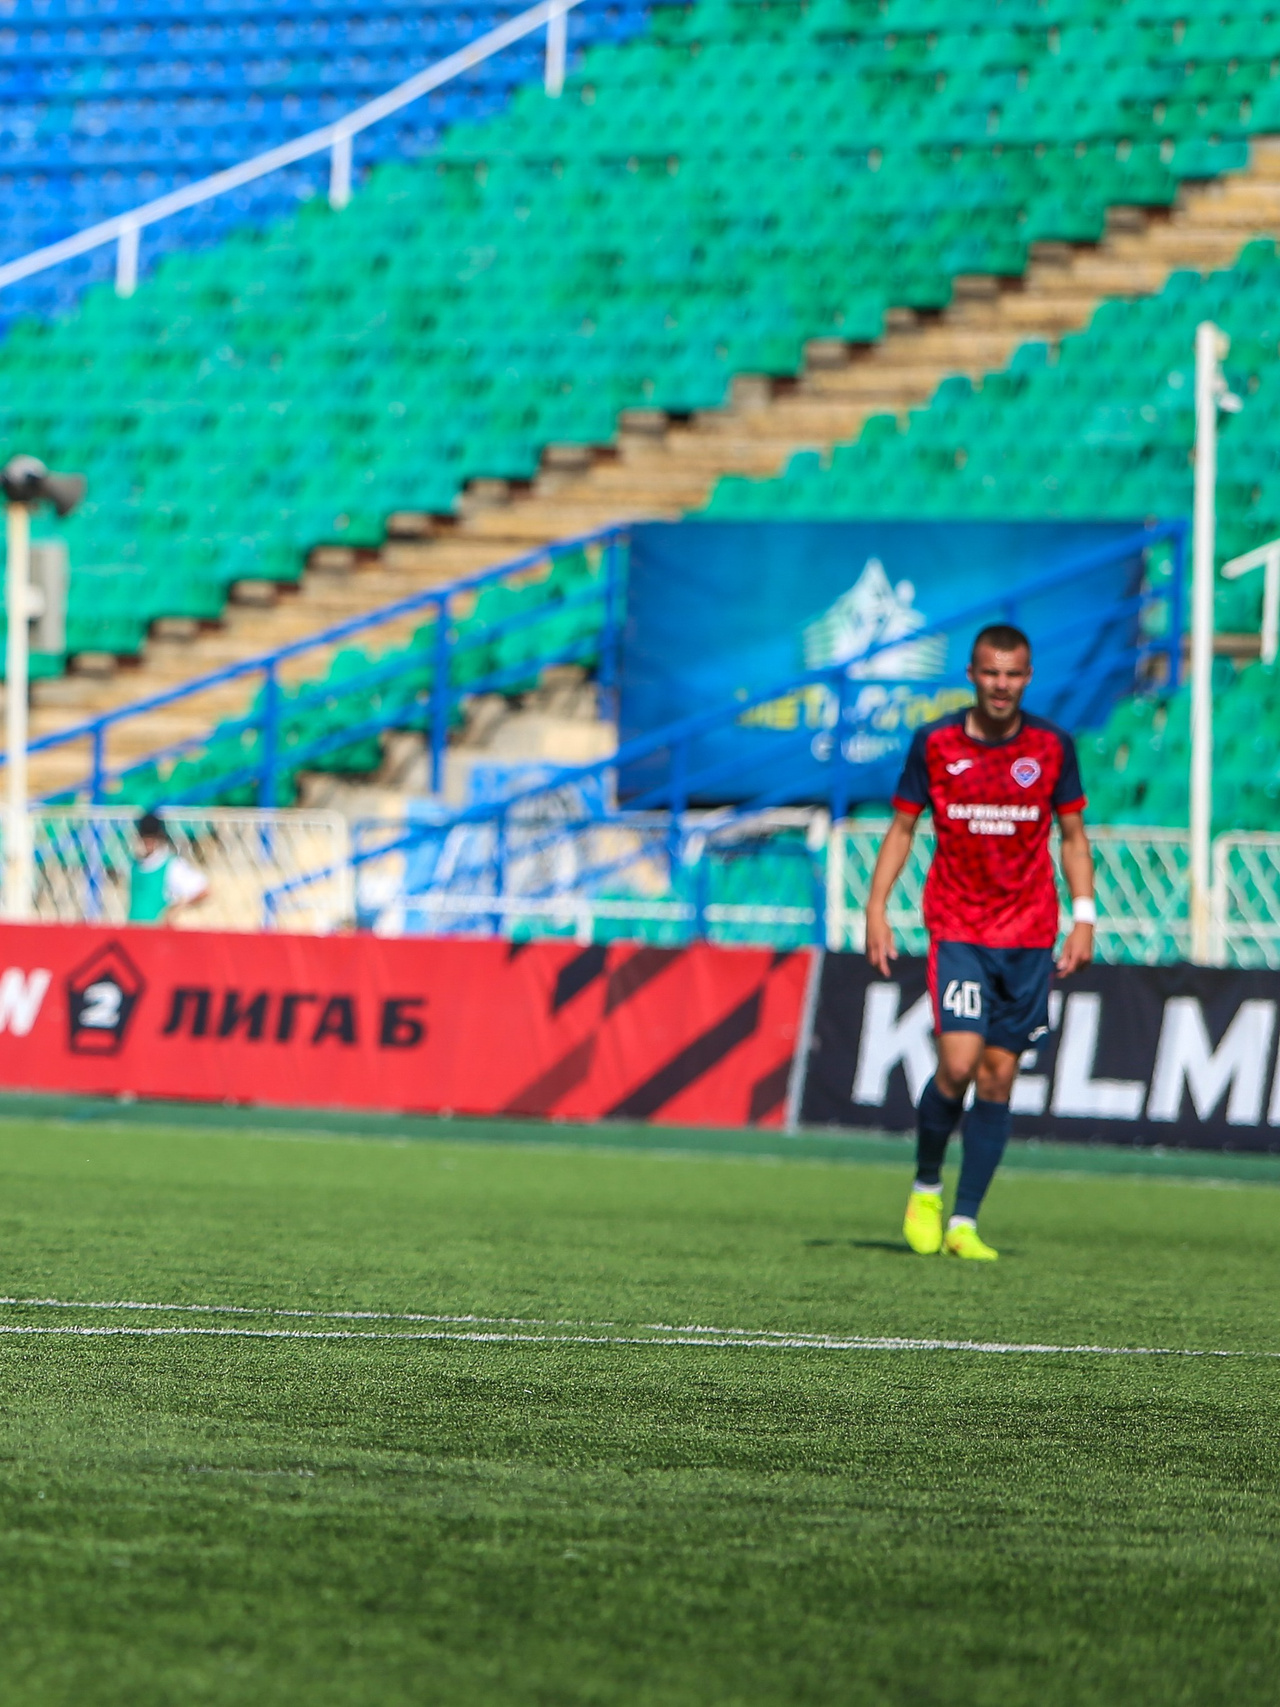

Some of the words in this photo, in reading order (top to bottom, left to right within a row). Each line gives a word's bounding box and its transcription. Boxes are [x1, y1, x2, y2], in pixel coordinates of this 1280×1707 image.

[79, 981, 123, 1029] 2
[161, 985, 360, 1046] ЛИГА
[378, 996, 429, 1049] Б
[942, 979, 983, 1020] 40
